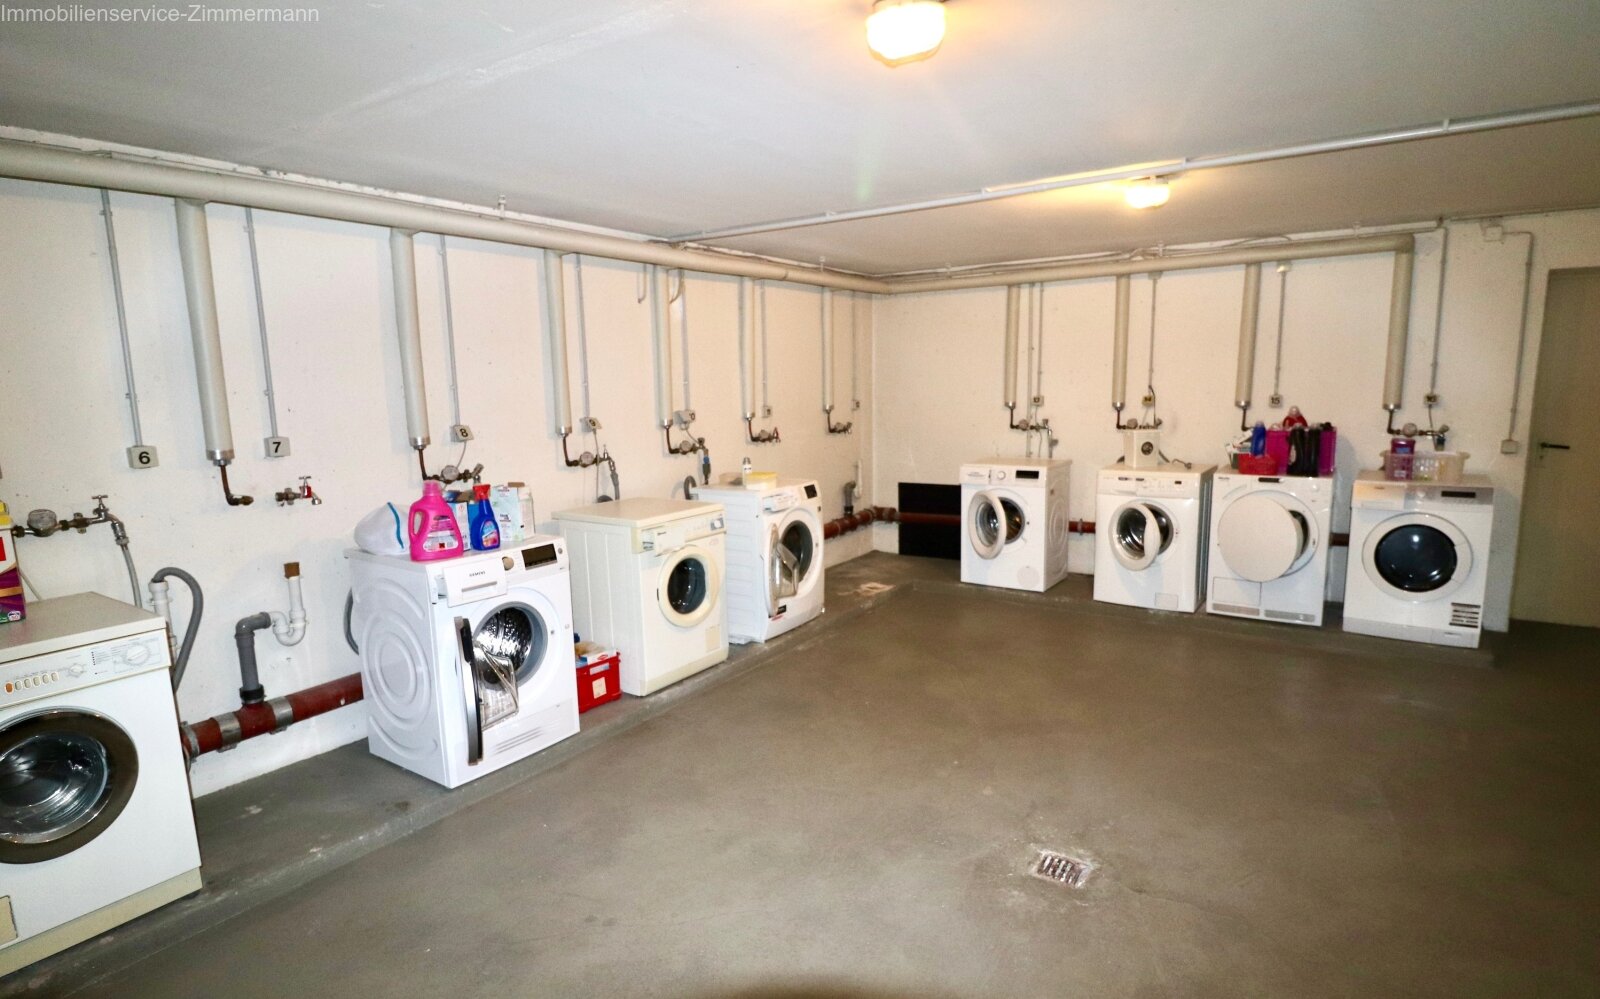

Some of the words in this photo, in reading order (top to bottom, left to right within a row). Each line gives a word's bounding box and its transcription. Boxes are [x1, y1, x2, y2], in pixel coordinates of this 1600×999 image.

[1271, 397, 1280, 405] 15
[588, 418, 596, 427] 9
[459, 428, 469, 438] 8
[272, 441, 282, 453] 7
[138, 451, 151, 465] 6
